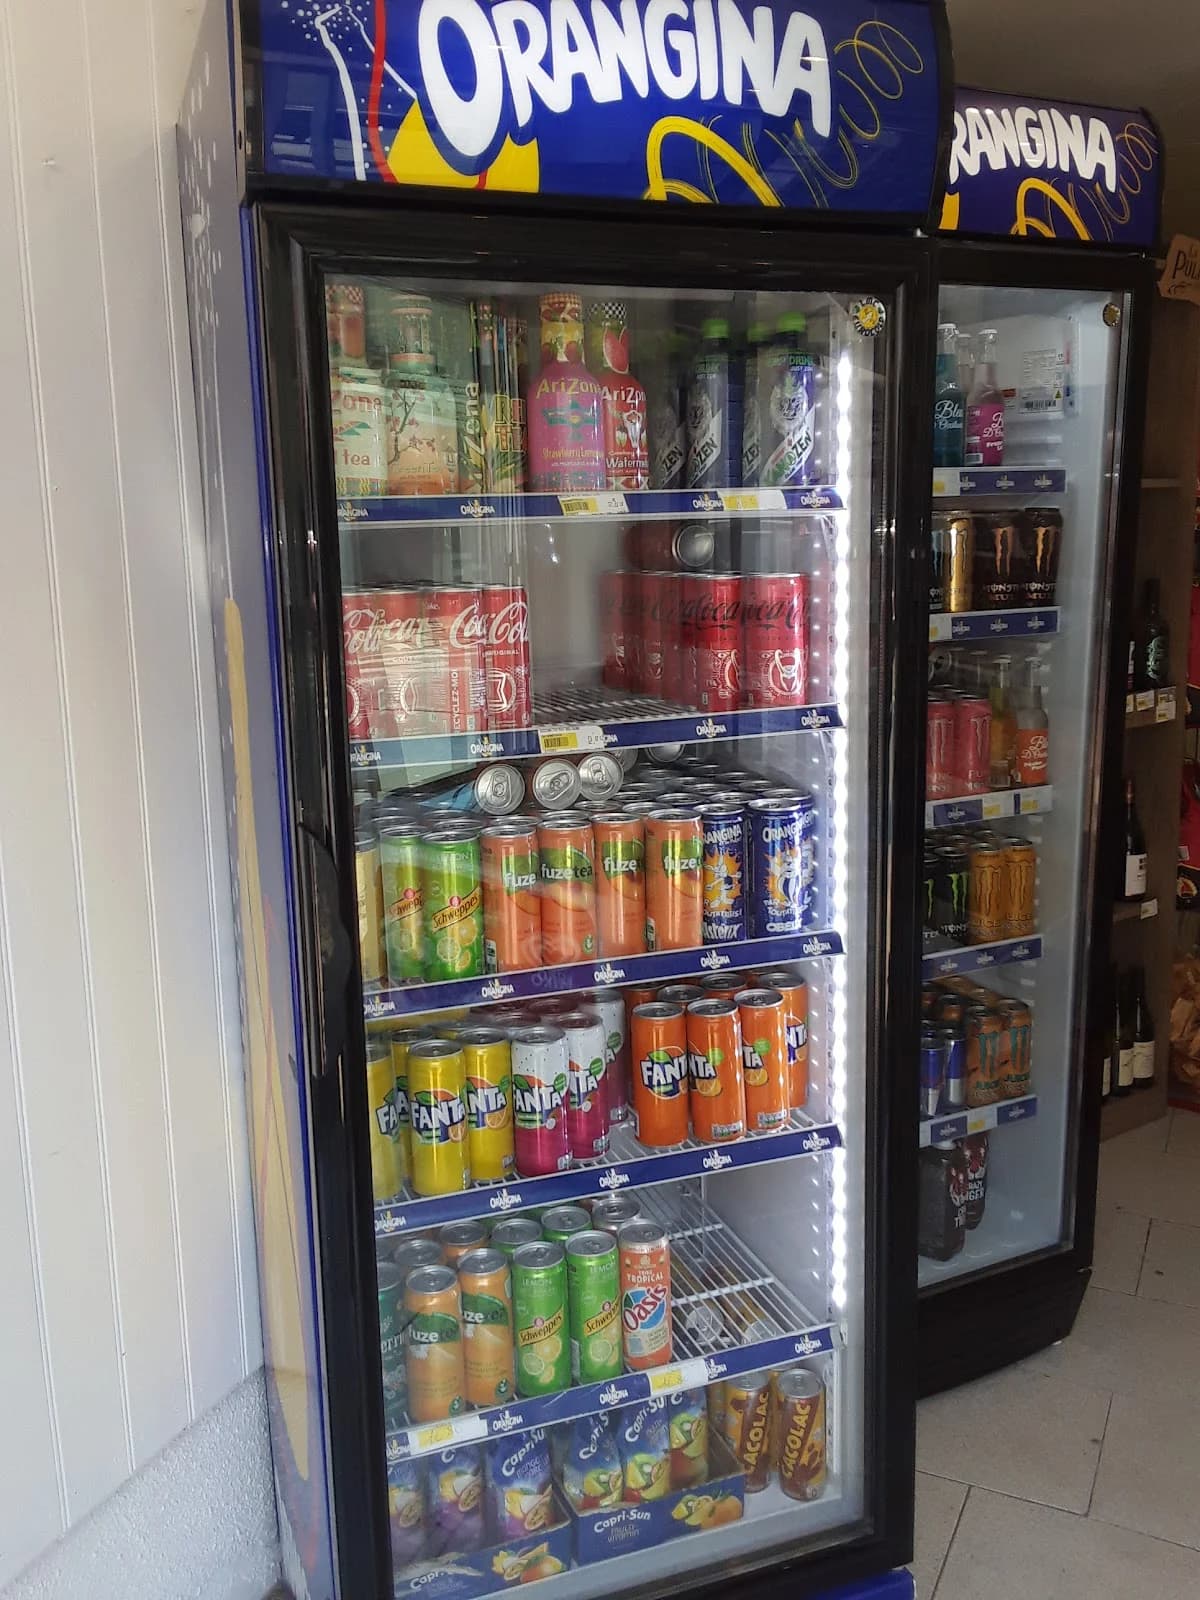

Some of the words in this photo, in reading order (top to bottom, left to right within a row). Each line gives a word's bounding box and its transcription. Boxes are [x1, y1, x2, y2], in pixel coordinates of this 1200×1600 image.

[418, 0, 832, 157] ORANGINA
[949, 106, 1116, 193] RANGINA
[342, 449, 371, 466] tea
[451, 668, 461, 730] ECYCLEZ-MOI
[470, 743, 504, 756] ORANGINA
[541, 863, 574, 880] fuze
[603, 857, 637, 872] fuze
[503, 871, 537, 888] fuze
[432, 894, 480, 929] Schweppes
[594, 967, 625, 982] ORANGINA
[482, 983, 514, 998] ORANGINA
[786, 1023, 808, 1048] NTA
[641, 1052, 688, 1086] FANT
[468, 1086, 507, 1113] NTA
[514, 1085, 562, 1112] ANTA
[411, 1096, 466, 1129] FANTA
[623, 1286, 667, 1331] Oasis
[520, 1313, 562, 1342] Schweppes
[593, 1509, 651, 1533] Capri-Sun
